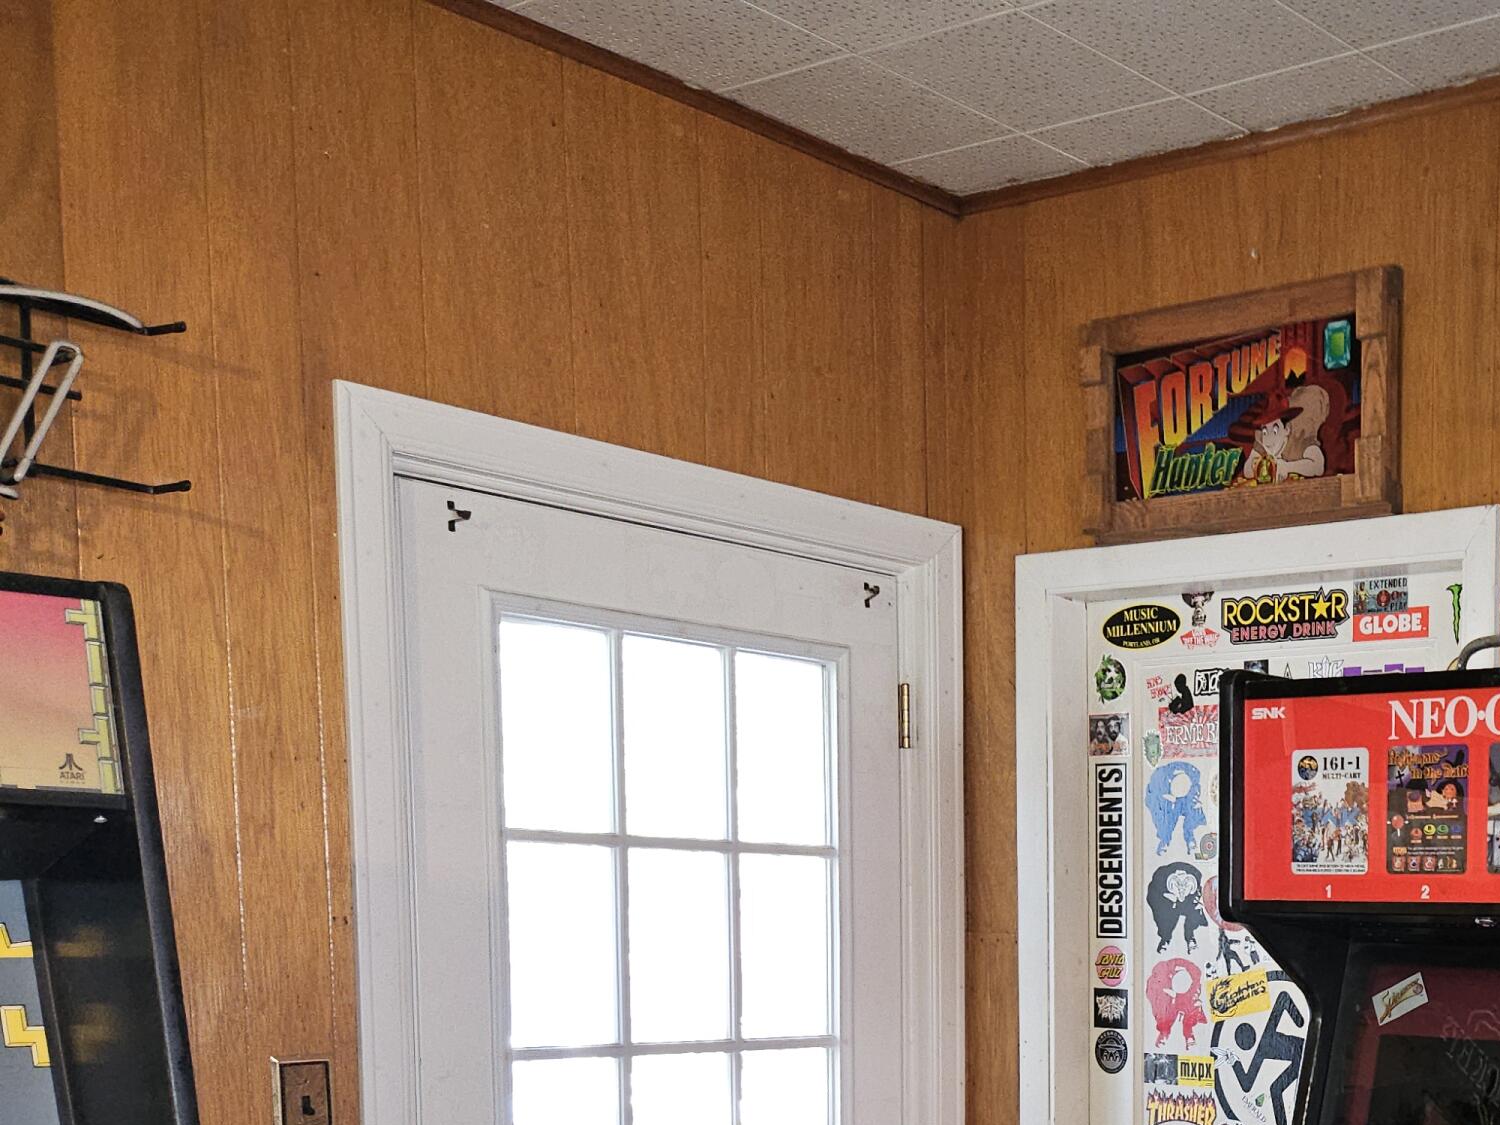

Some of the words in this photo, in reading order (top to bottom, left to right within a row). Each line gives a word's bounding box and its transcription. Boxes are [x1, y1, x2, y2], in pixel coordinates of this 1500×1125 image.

[1133, 334, 1282, 499] FORTUNE
[1150, 442, 1243, 494] Hunter
[1369, 578, 1407, 590] EXTENDED
[1124, 607, 1159, 622] MUSIC
[1106, 620, 1177, 637] MILLENNIUM
[1232, 622, 1288, 642] ENERGY
[1292, 621, 1337, 638] DRINK
[1251, 706, 1286, 720] SNK
[1166, 723, 1204, 744] ERNIE
[1323, 756, 1360, 771] 161-1
[1098, 768, 1123, 934] DESCENDENTS
[1326, 885, 1332, 898] 1
[1421, 885, 1430, 899] 2
[1095, 953, 1125, 965] SANTA
[1099, 966, 1123, 979] CRUZ
[1180, 1061, 1212, 1079] mxpx
